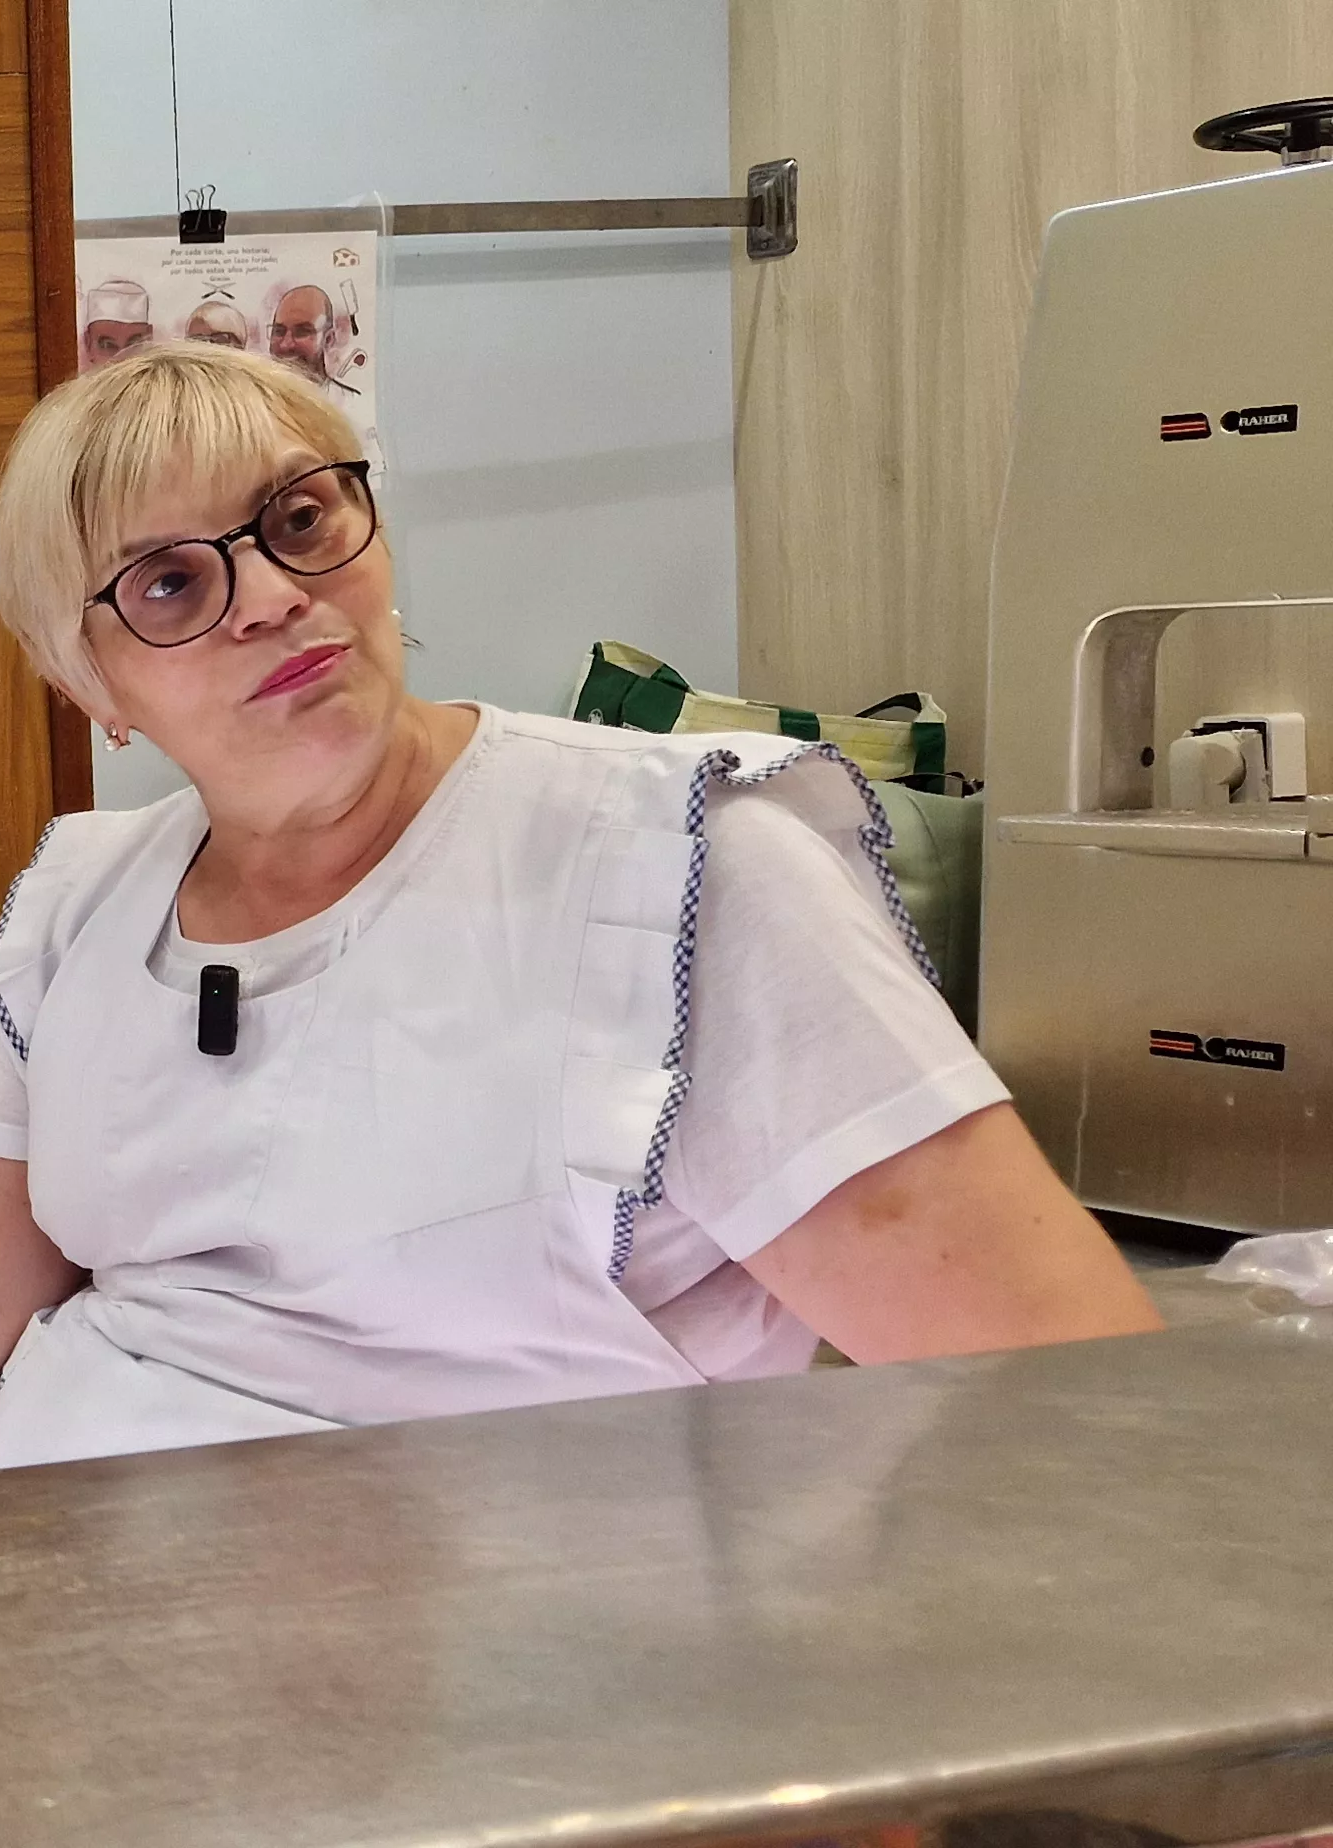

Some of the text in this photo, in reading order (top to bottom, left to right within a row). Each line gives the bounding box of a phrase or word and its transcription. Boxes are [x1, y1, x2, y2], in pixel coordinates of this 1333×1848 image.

[170, 248, 182, 257] Por
[1238, 413, 1289, 427] RAHER
[1225, 1047, 1276, 1062] RAHER
